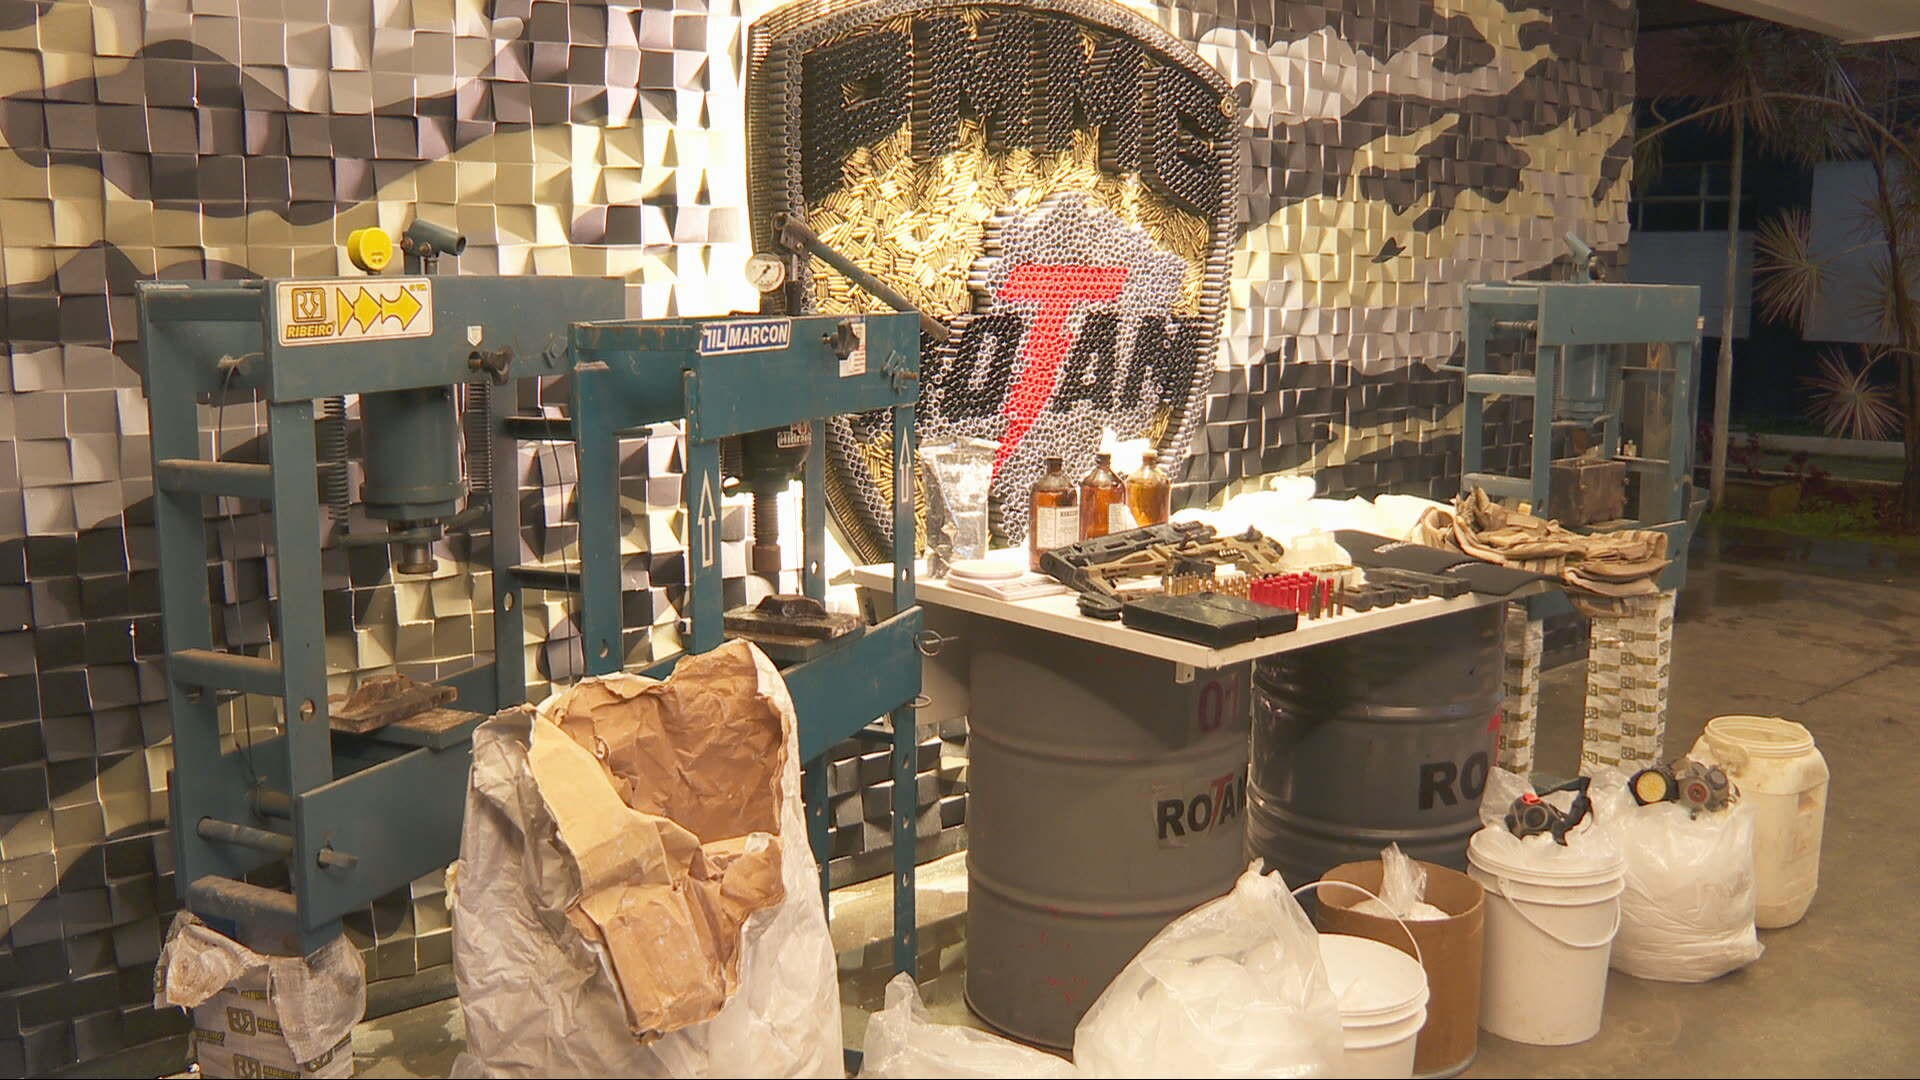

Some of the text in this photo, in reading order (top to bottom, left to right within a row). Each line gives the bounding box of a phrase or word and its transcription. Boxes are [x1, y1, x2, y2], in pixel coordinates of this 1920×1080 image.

[286, 322, 334, 339] RIBEIRO
[729, 325, 788, 346] MARCON
[1198, 672, 1241, 733] 01
